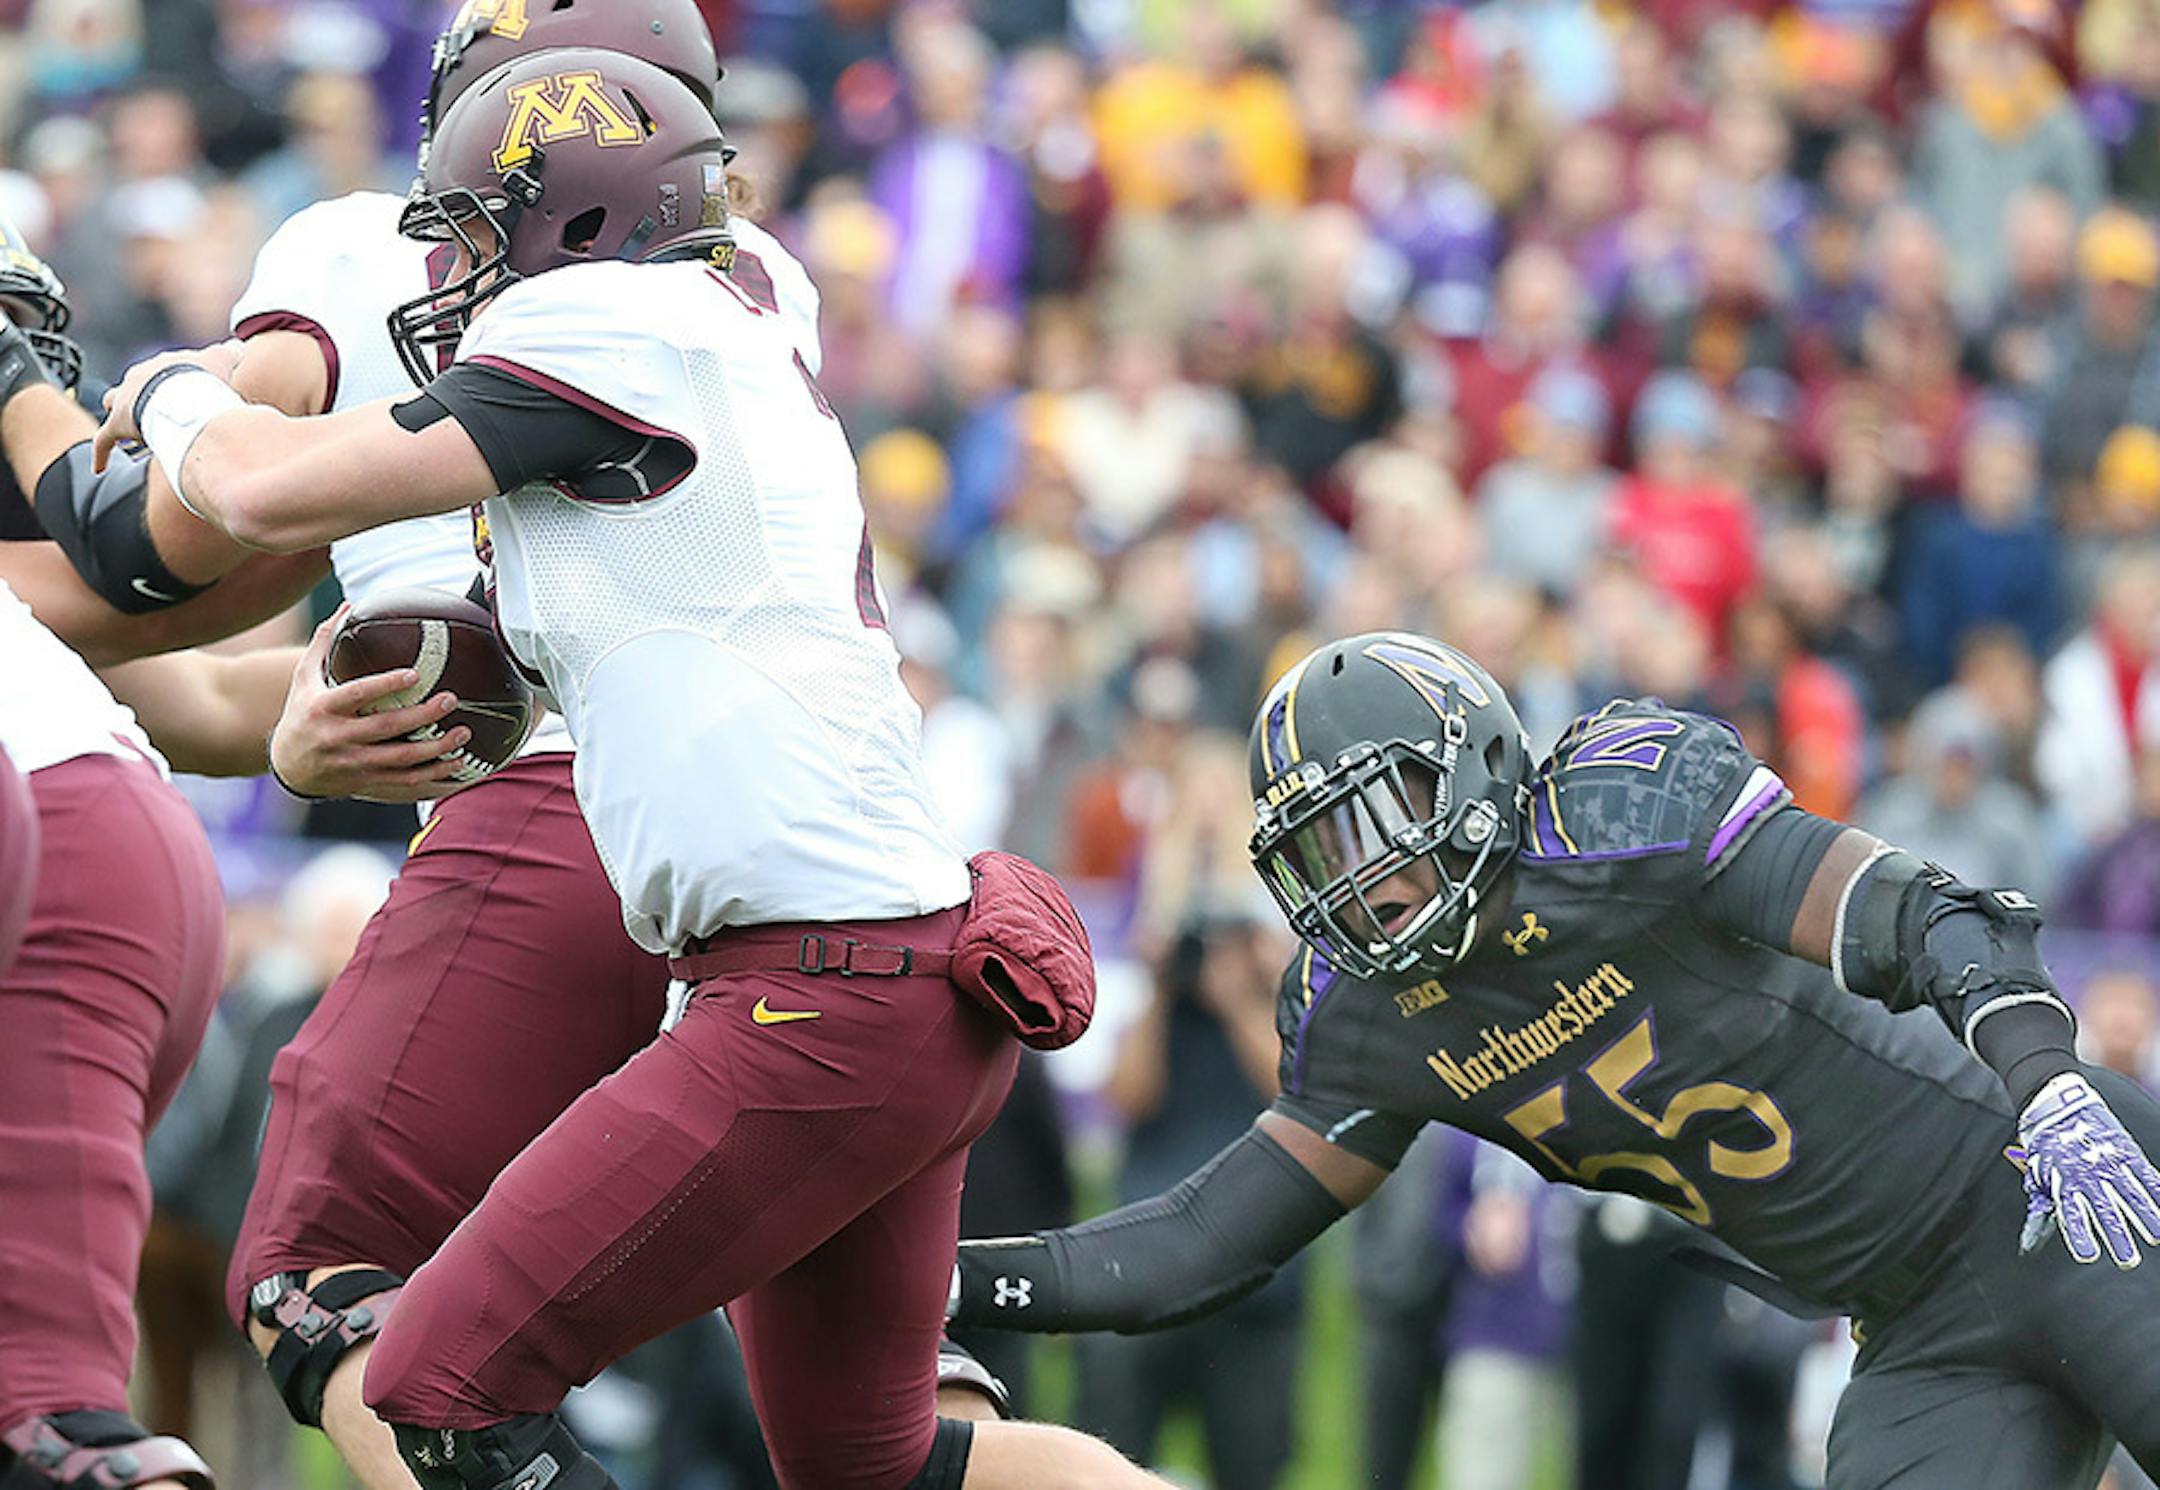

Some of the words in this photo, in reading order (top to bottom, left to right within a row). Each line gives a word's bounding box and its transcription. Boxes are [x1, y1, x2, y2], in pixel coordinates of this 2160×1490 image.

[492, 69, 644, 173] M
[1426, 962, 1635, 1101] Northwestern
[1502, 1003, 1797, 1228] 55
